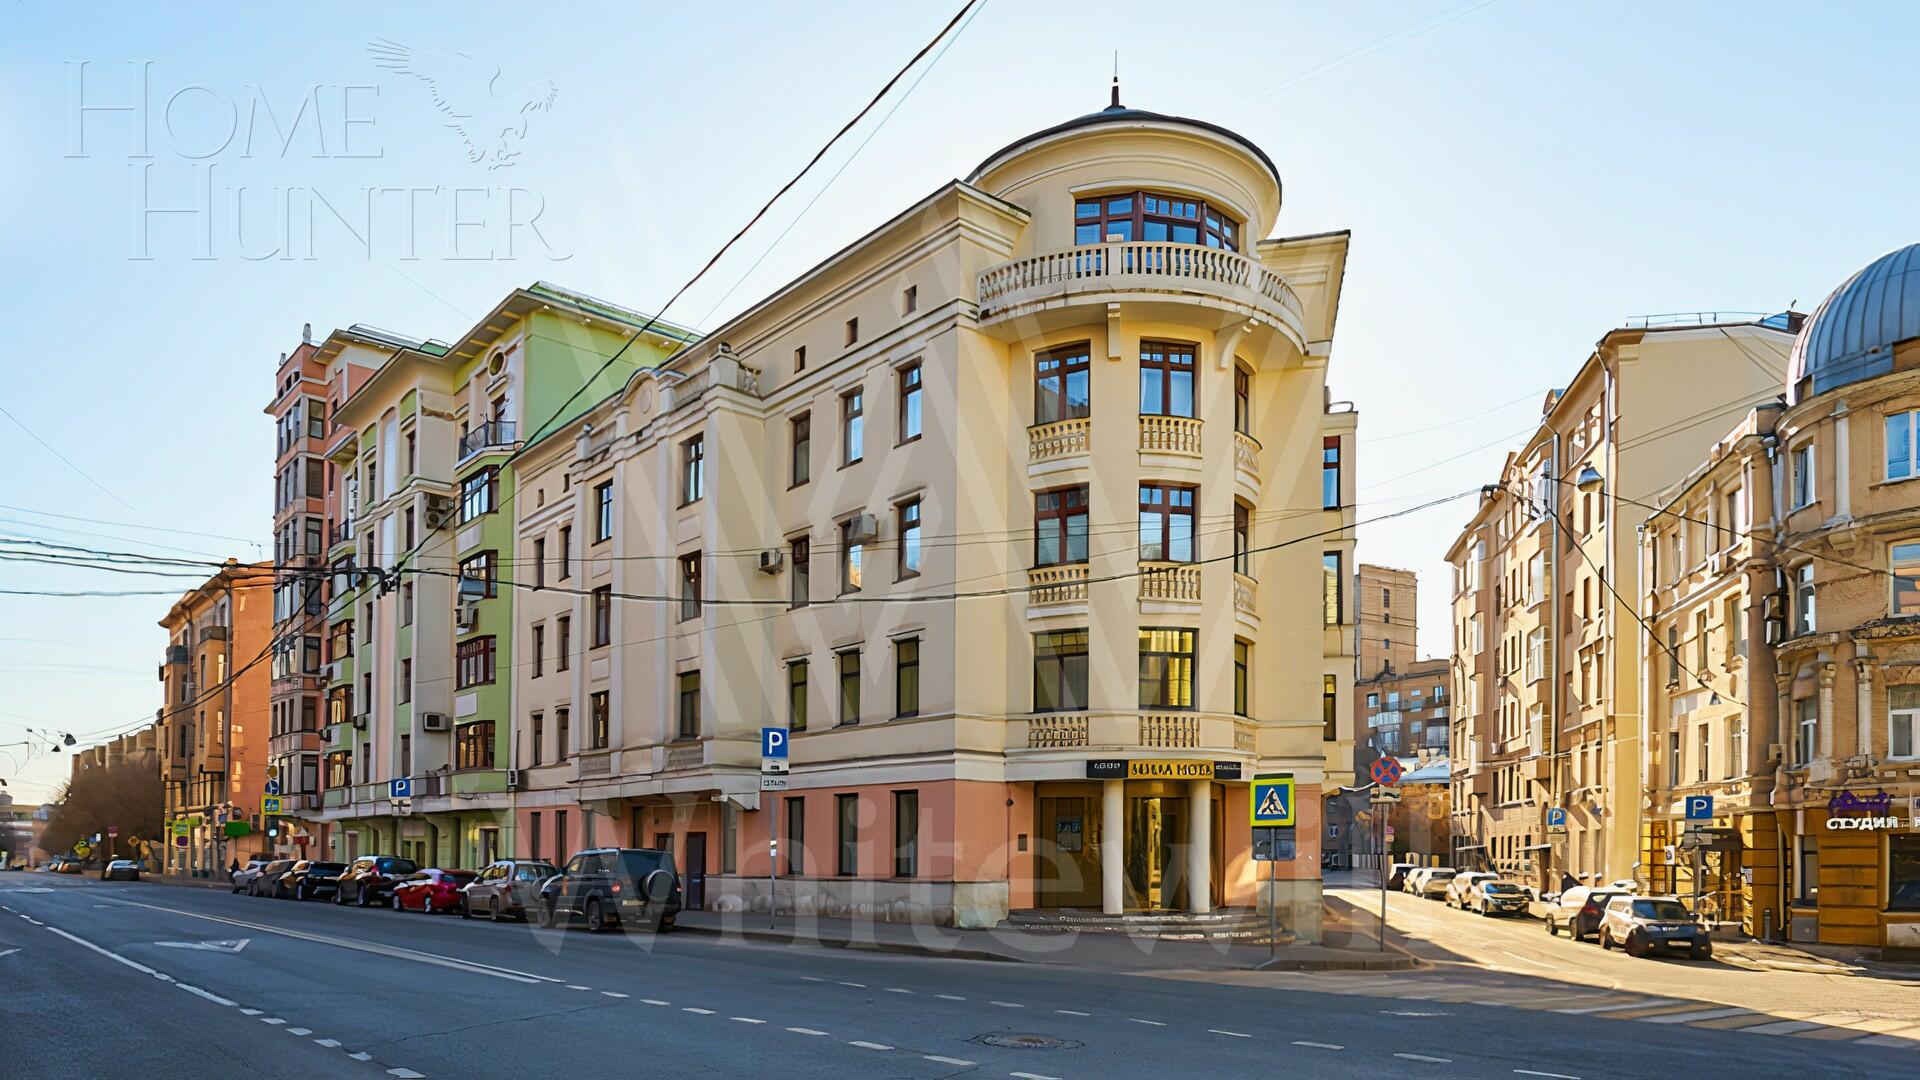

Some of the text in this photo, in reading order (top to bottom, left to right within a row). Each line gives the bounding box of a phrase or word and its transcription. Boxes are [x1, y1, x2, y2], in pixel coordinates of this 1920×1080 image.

[768, 731, 783, 755] P
[396, 780, 406, 797] P
[1692, 799, 1707, 817] P
[1552, 811, 1562, 823] P
